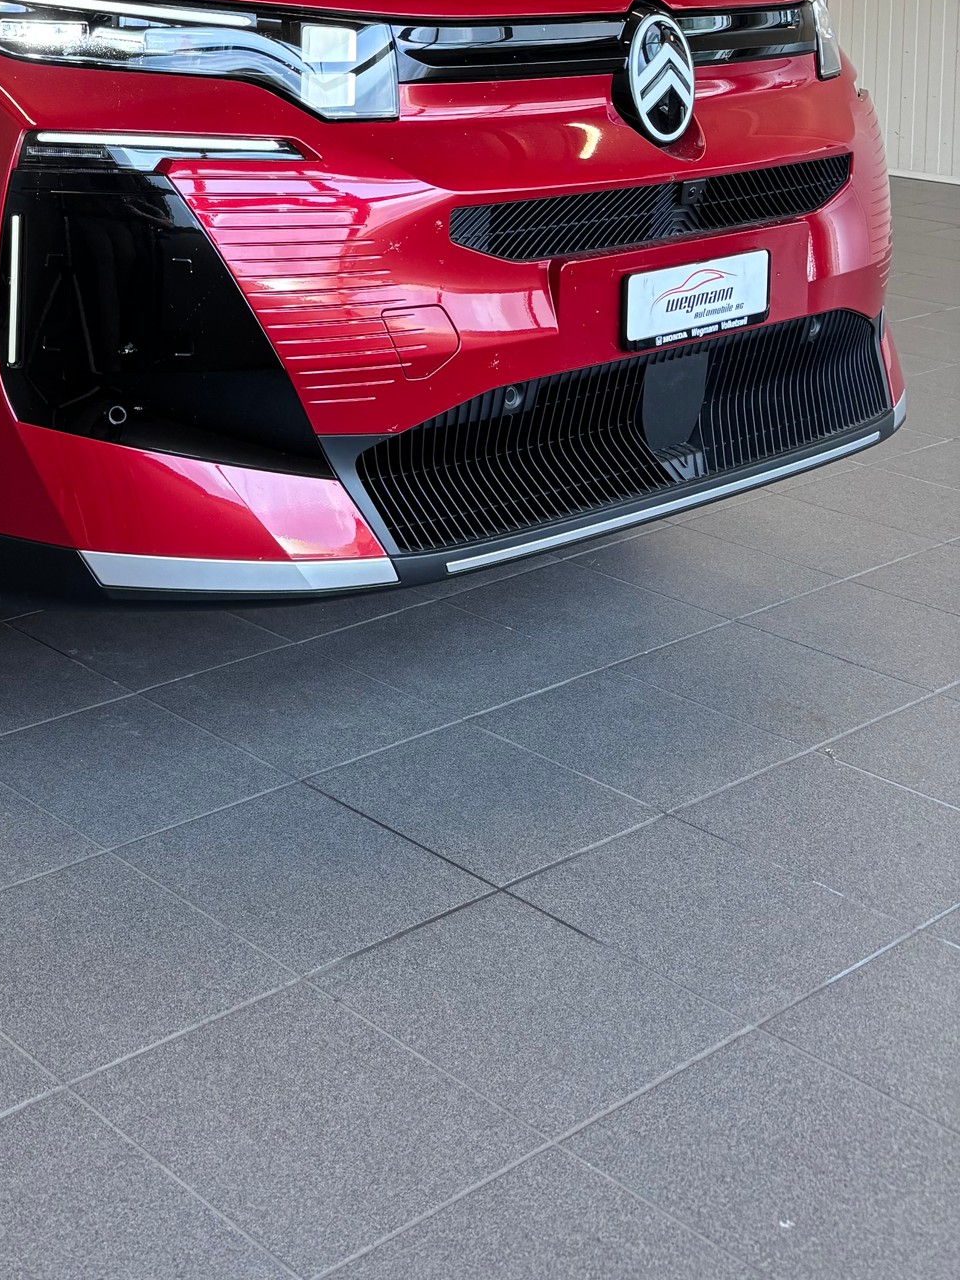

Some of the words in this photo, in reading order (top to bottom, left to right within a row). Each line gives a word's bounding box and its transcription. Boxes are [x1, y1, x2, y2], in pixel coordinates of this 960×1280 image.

[665, 286, 734, 314] wegmann
[662, 331, 688, 343] HONDA
[691, 324, 719, 337] Wegmann
